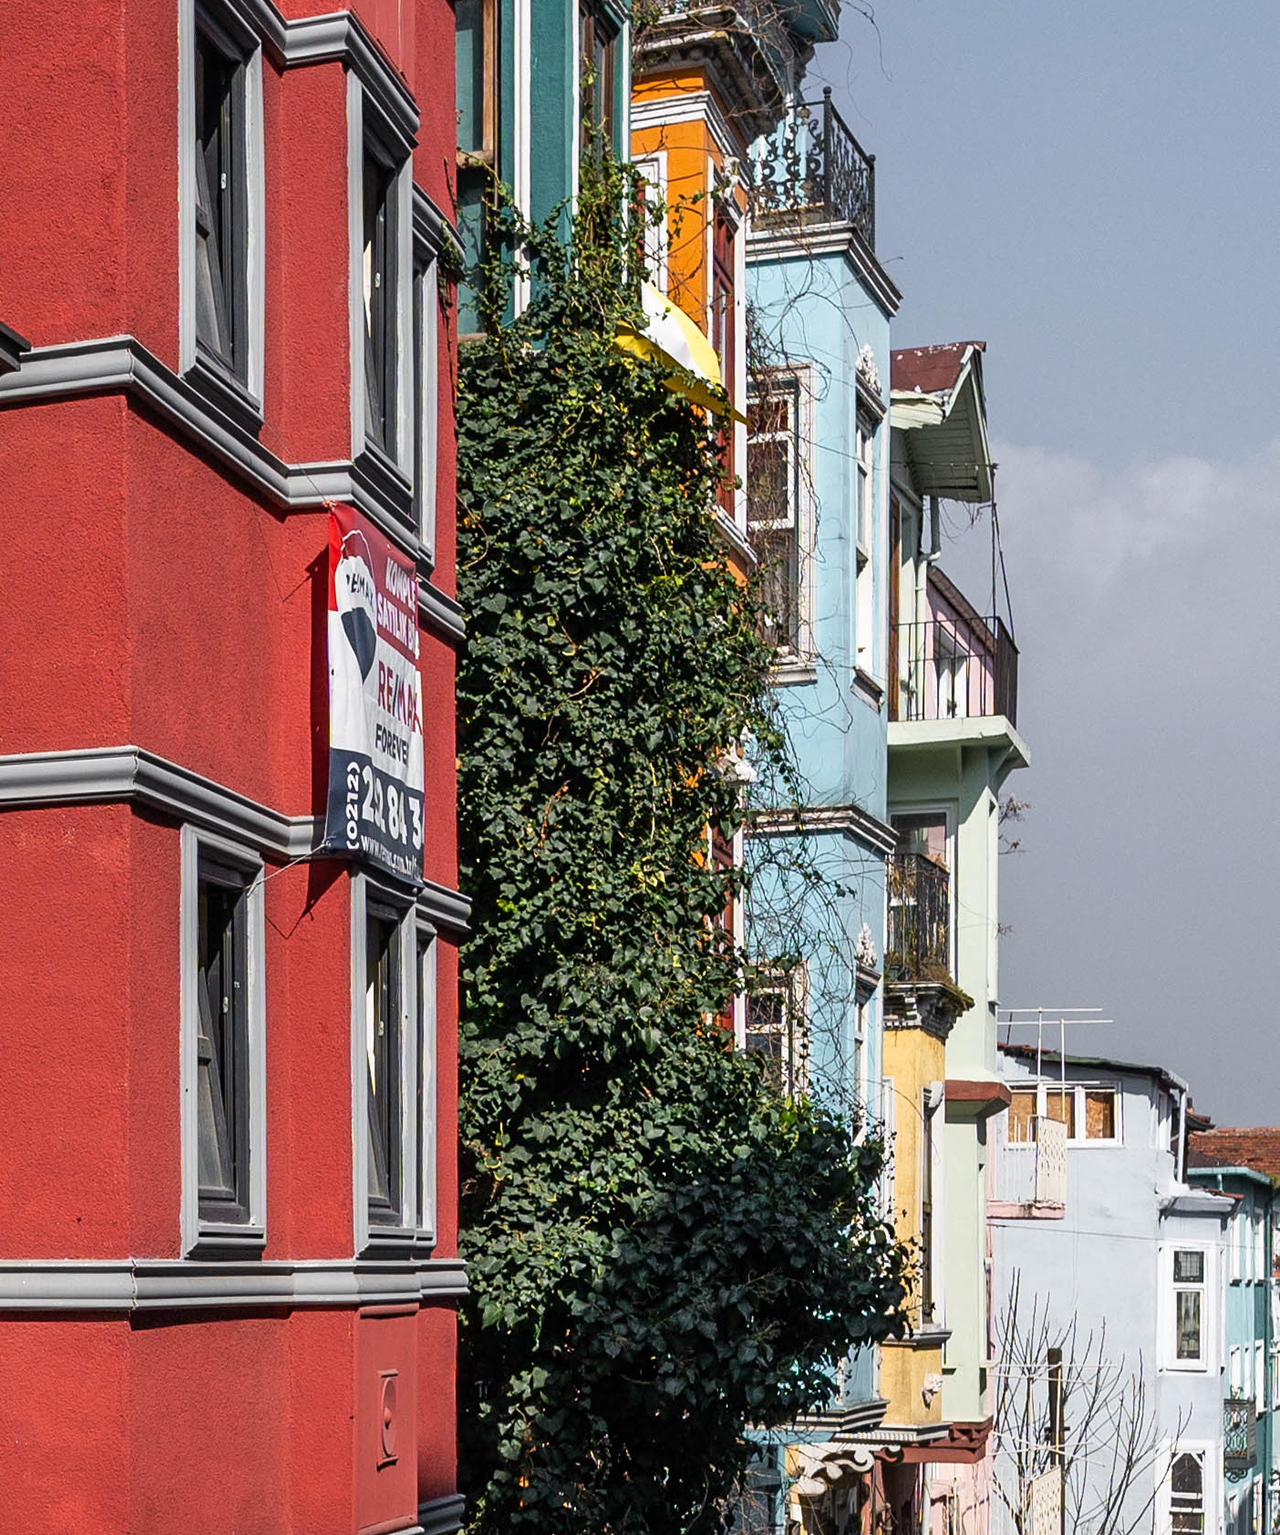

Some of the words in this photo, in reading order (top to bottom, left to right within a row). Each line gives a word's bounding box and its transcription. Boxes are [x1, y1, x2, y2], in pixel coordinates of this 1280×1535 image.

[385, 557, 416, 612] KOMPLE
[377, 660, 424, 736] RE/MAX
[346, 761, 361, 850] (0212)
